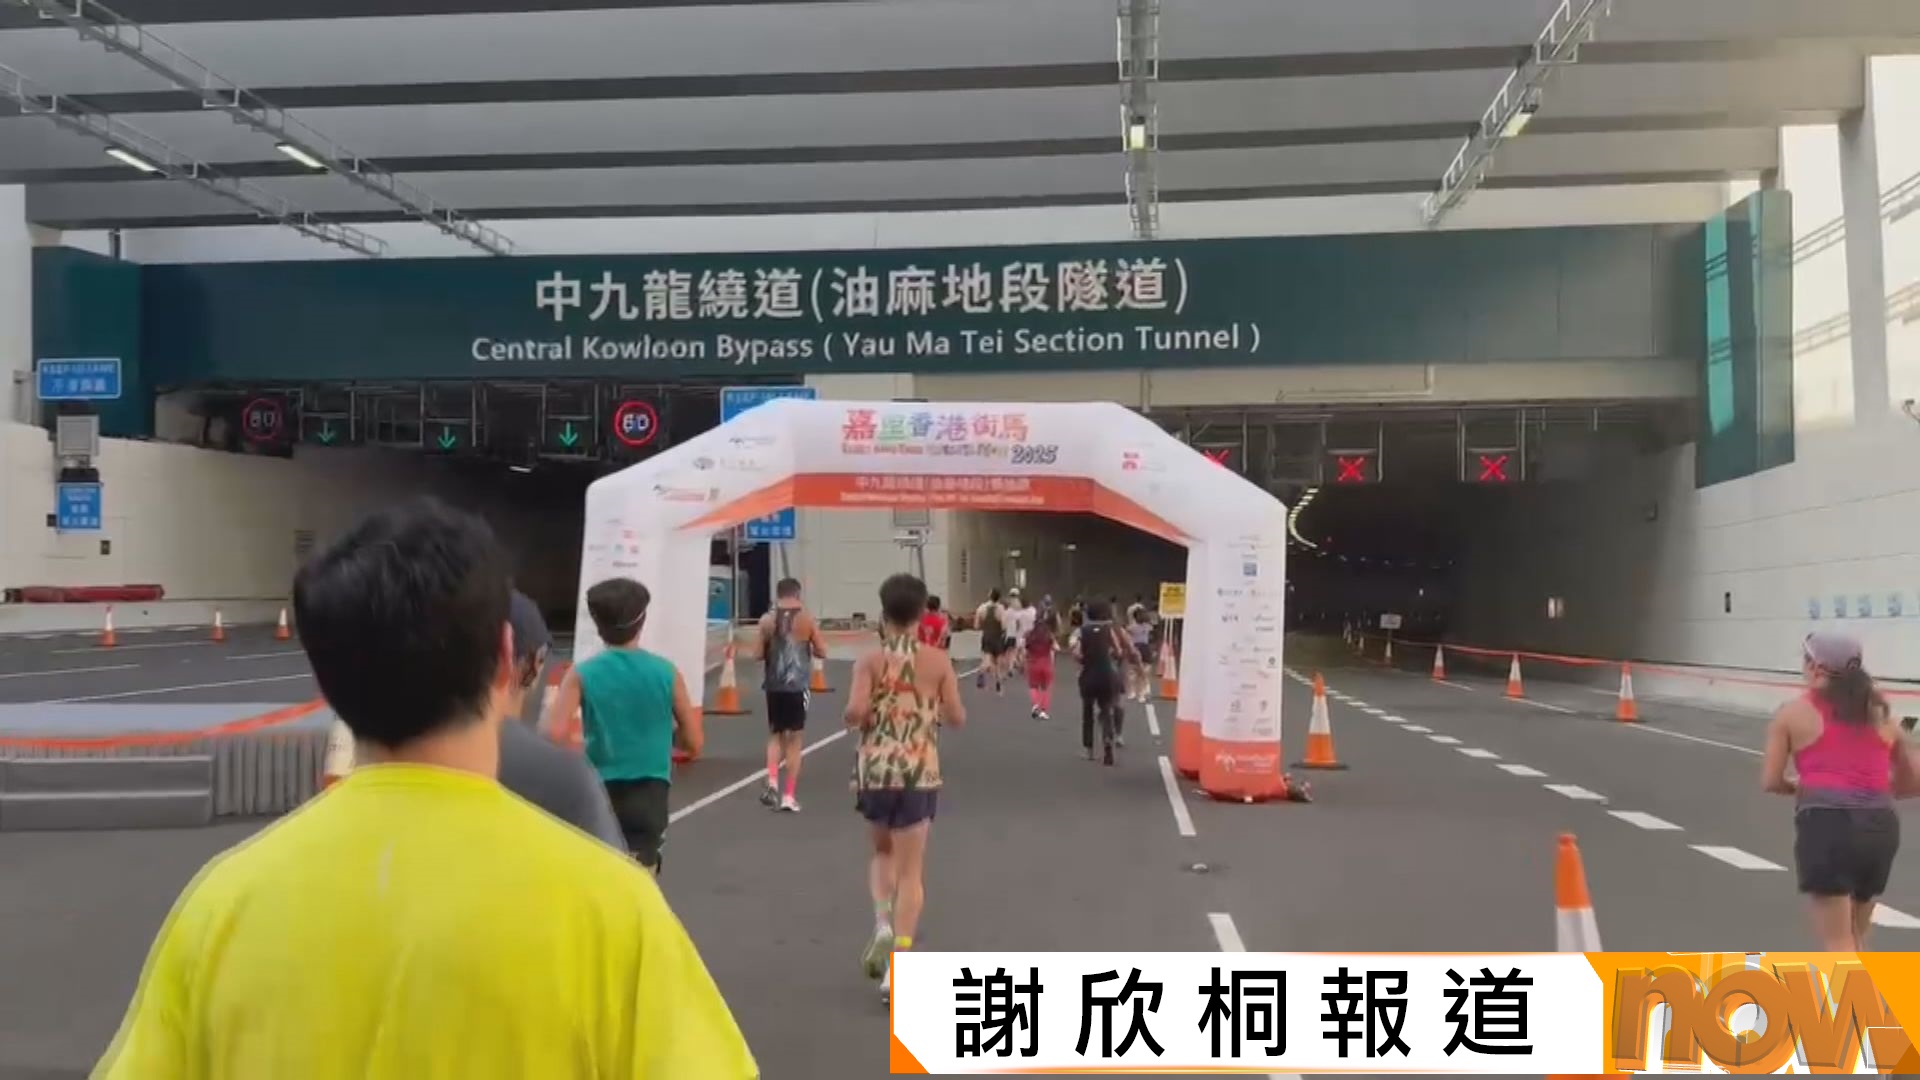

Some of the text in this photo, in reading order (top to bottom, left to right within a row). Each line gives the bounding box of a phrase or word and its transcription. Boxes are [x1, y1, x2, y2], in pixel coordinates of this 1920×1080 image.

[536, 258, 1188, 322] 中九龍繞道(油麻地段隧道)
[471, 335, 572, 361] Central
[583, 333, 705, 361] Kowloon
[716, 333, 813, 366] Bypass
[843, 332, 895, 357] Yau
[907, 331, 950, 356] Ma
[961, 329, 1003, 354] Tei
[1015, 326, 1125, 353] Section
[1136, 323, 1239, 351] Tunnel
[1011, 444, 1058, 464] 2025
